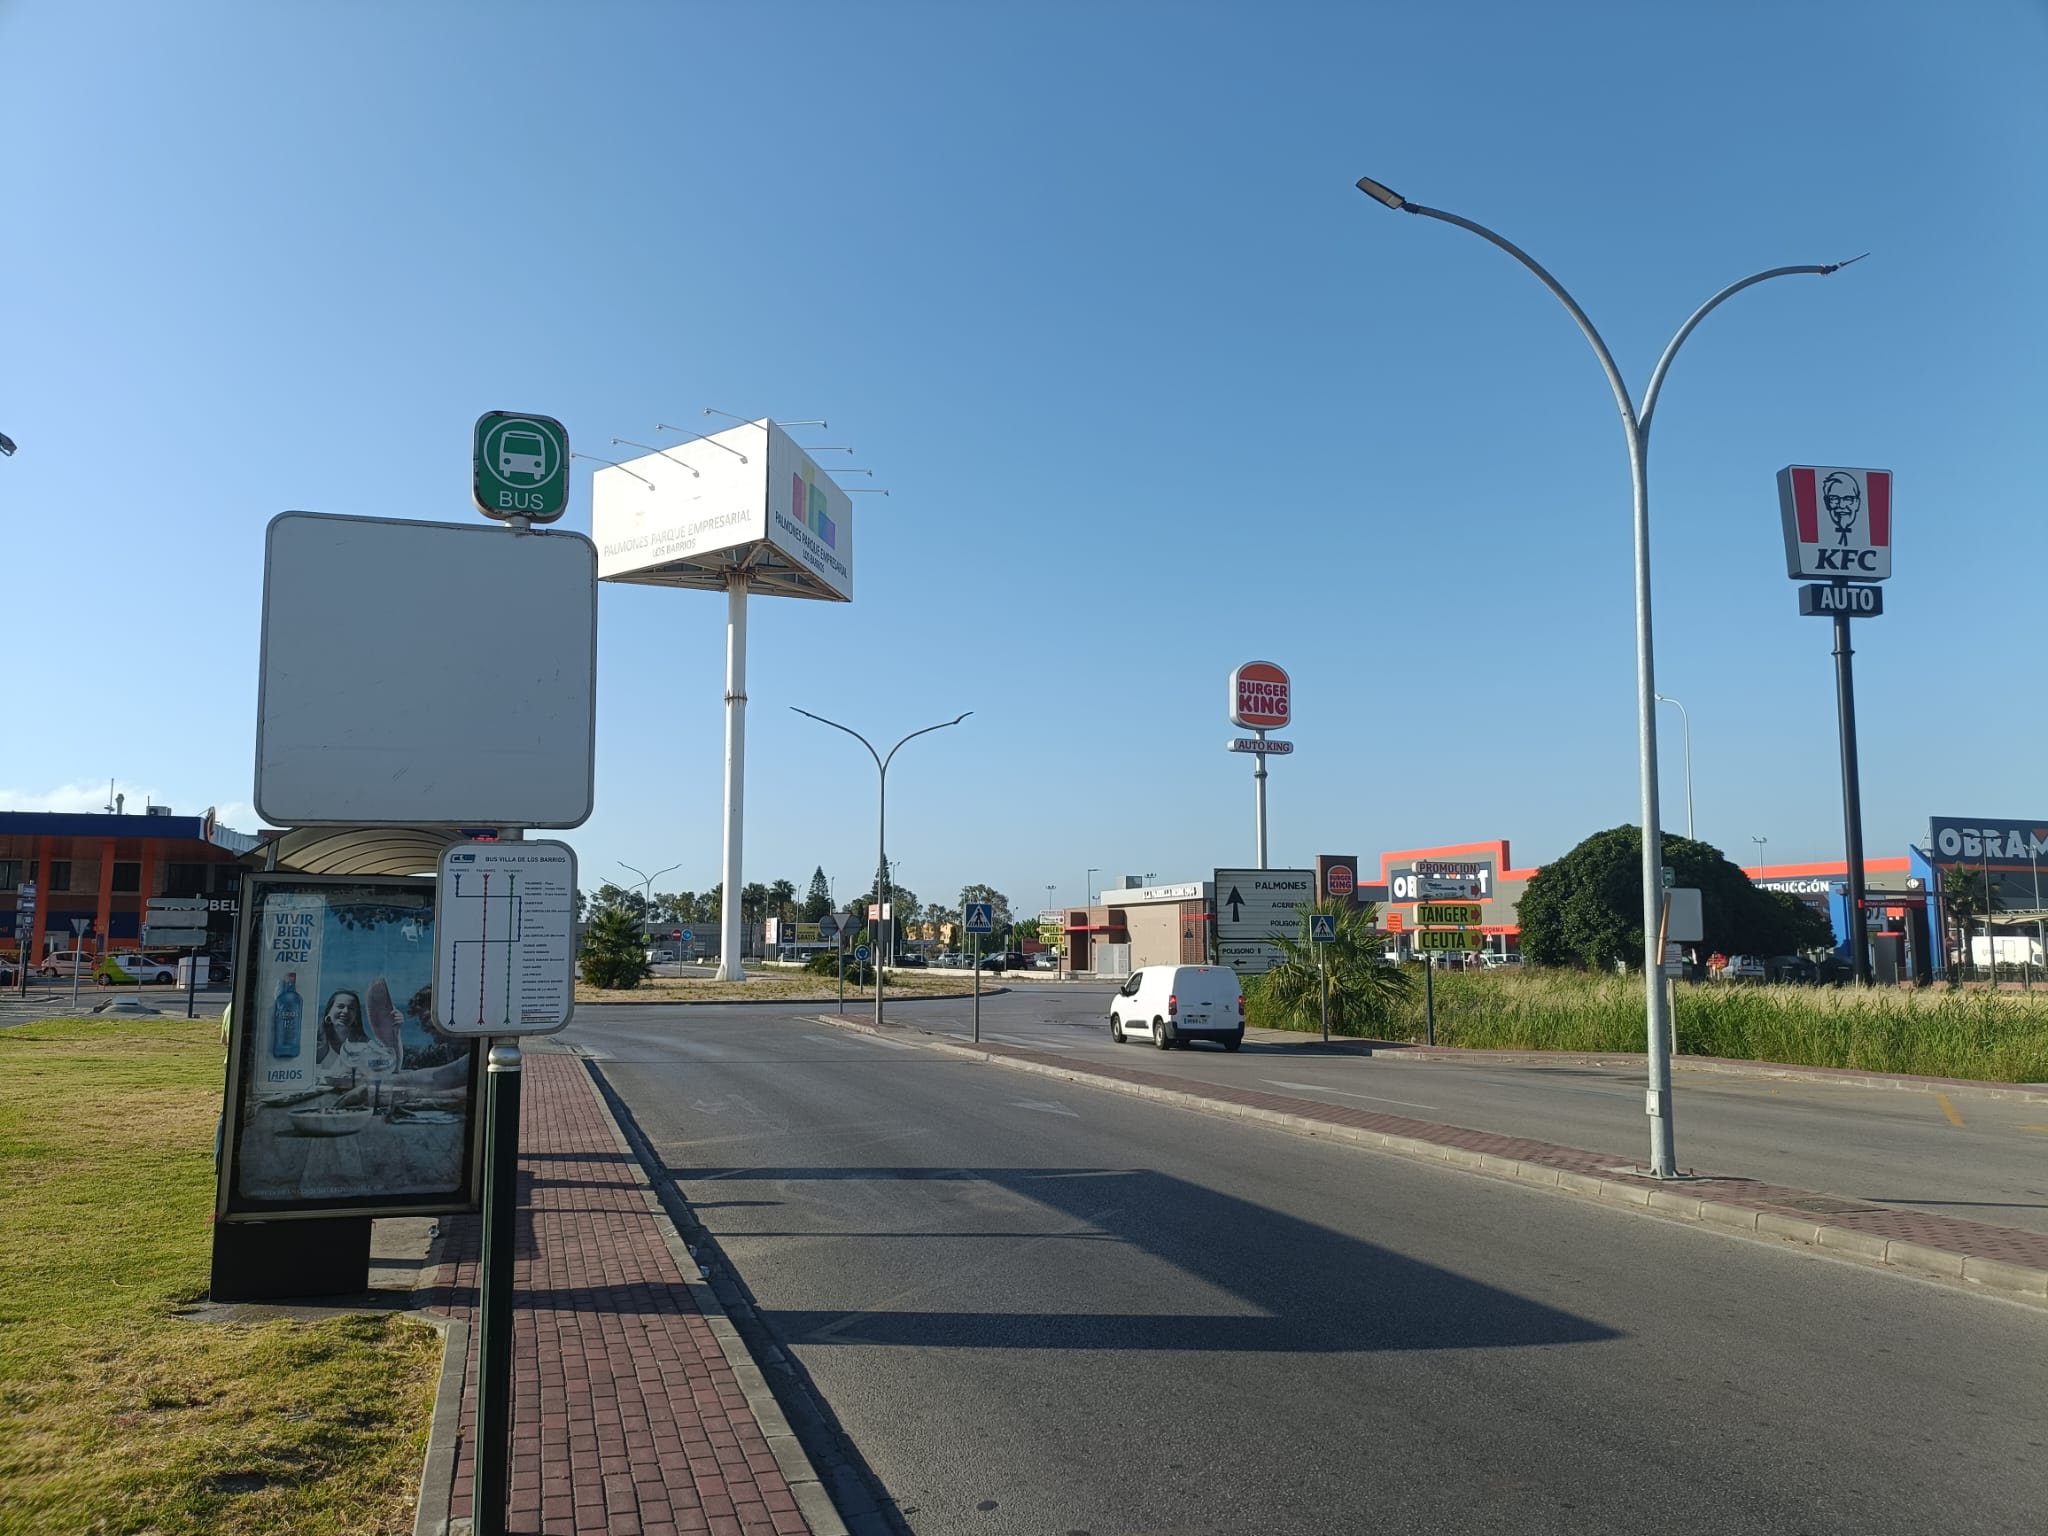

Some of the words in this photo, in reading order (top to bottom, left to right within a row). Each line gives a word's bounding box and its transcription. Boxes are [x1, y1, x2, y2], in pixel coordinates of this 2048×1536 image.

[499, 490, 544, 510] BUS
[603, 535, 649, 558] PALMONES
[651, 524, 686, 546] PARQUE
[687, 508, 752, 537] EMPRESARIAL
[652, 545, 665, 558] LOS
[666, 538, 696, 555] BARRIOS
[775, 510, 802, 541] PALMONES
[802, 532, 820, 556] PARQUE
[820, 548, 848, 579] EMPRESARIAL
[1815, 548, 1877, 572] KFC
[1820, 586, 1875, 611] AUTO
[1239, 681, 1288, 697] BURGER
[1239, 695, 1288, 715] KING
[1238, 740, 1265, 751] AUTO
[1266, 742, 1290, 752] KING
[1420, 863, 1477, 874] PROMOCION
[1255, 881, 1308, 890] PALMONES
[1329, 880, 1352, 889] KING
[276, 913, 315, 927] VIVIR
[1420, 906, 1469, 923] TANGER
[277, 926, 309, 937] BIEN
[1421, 933, 1466, 949] CEUTA
[274, 951, 309, 963] ARTE
[267, 1069, 303, 1082] LARIOS
